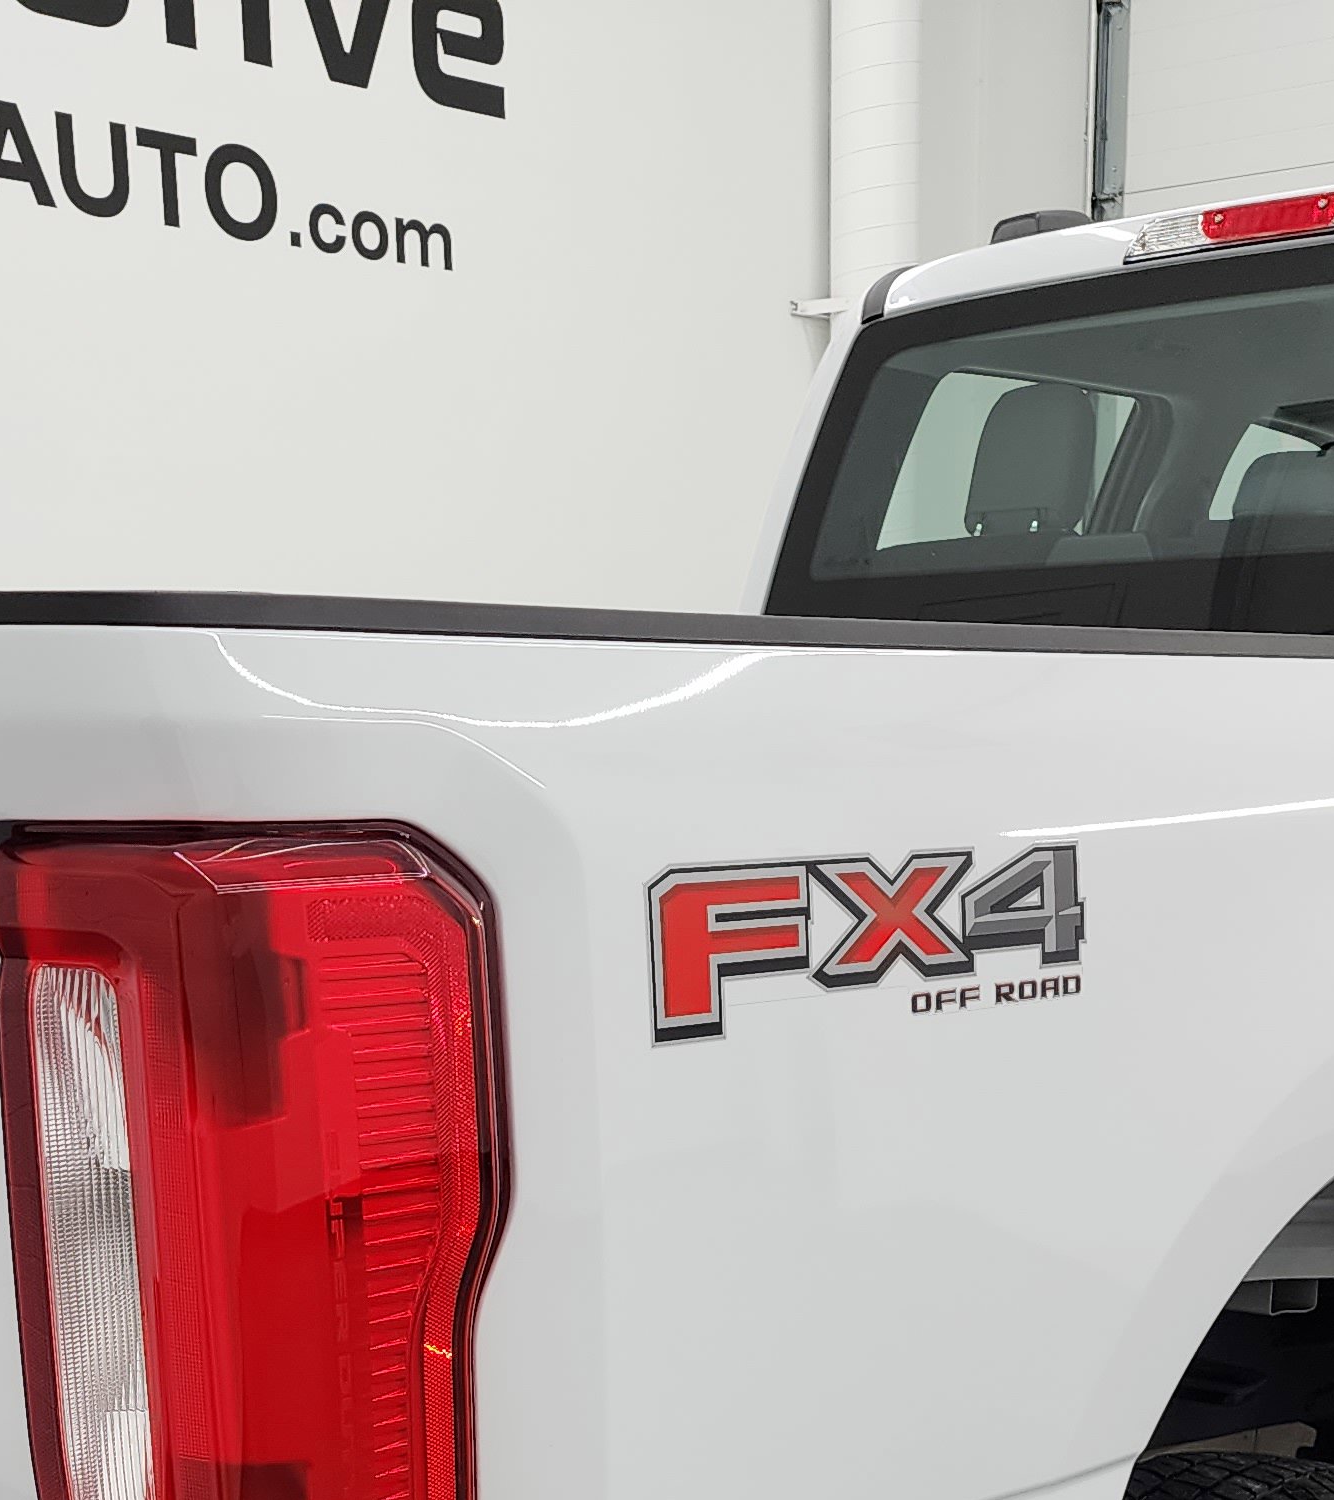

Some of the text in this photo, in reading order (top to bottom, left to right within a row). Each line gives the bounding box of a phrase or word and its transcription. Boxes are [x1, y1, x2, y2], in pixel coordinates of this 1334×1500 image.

[643, 838, 1086, 1048] FX4
[910, 973, 1083, 1015] OFF ROAD
